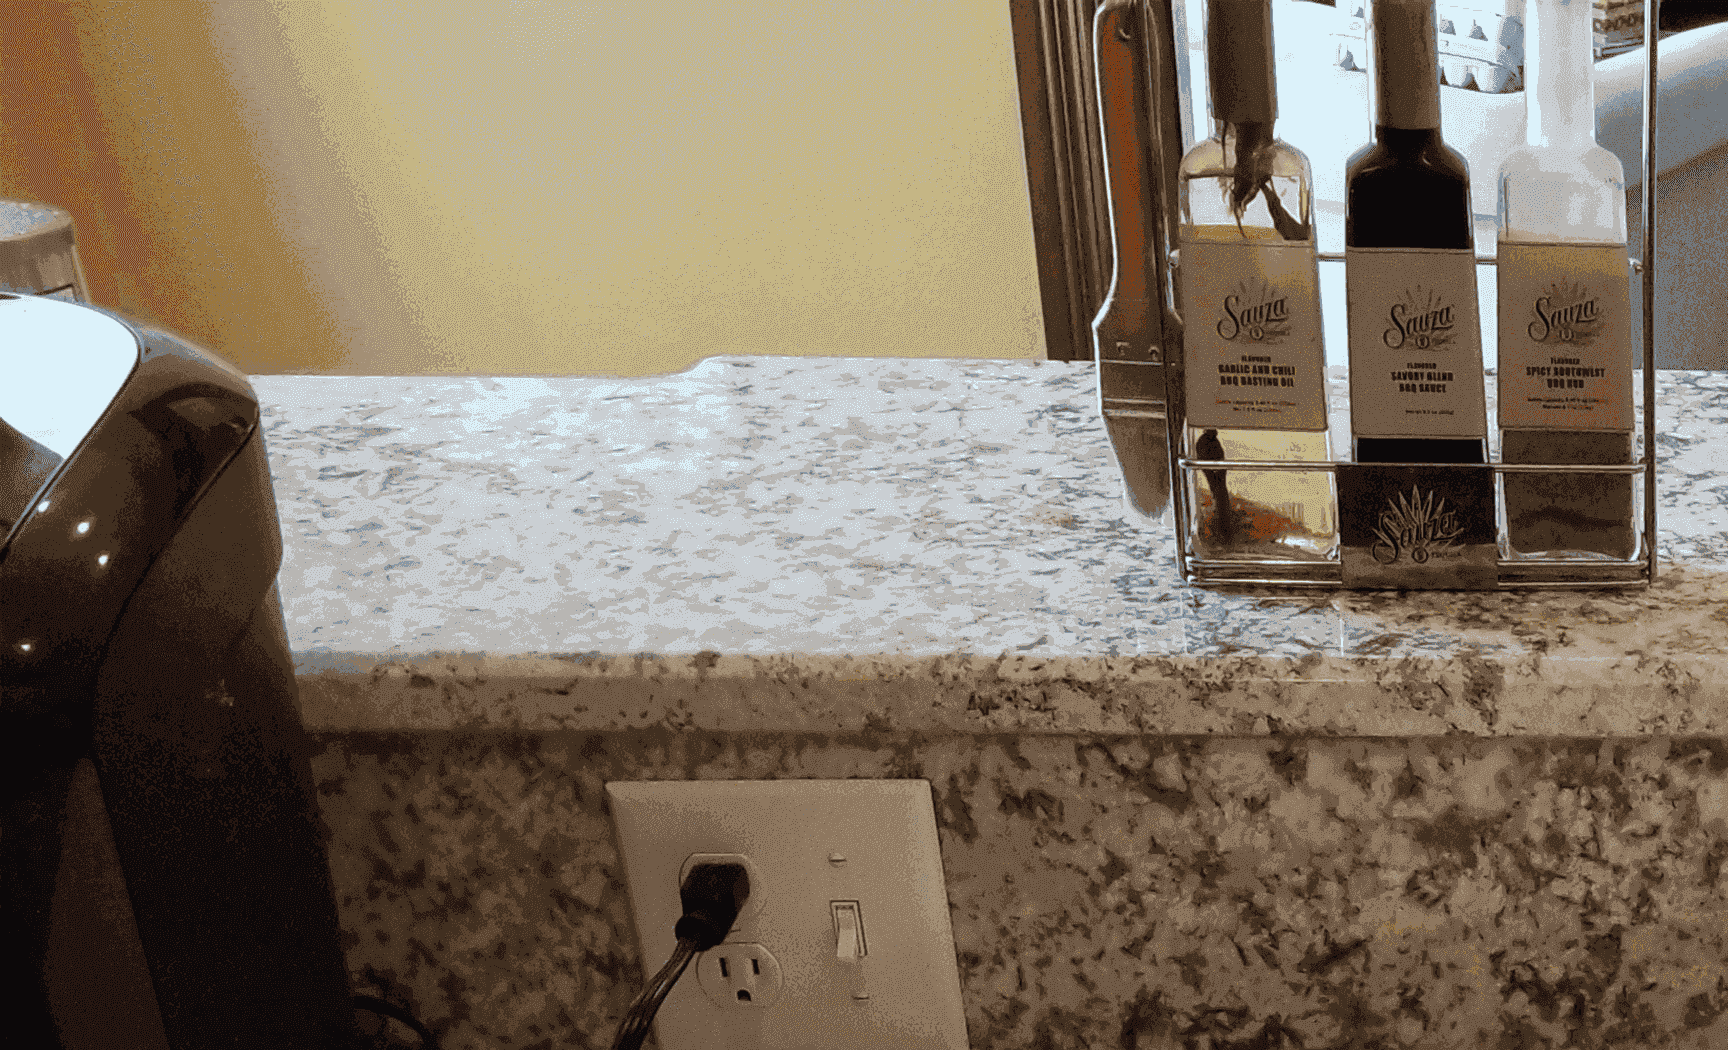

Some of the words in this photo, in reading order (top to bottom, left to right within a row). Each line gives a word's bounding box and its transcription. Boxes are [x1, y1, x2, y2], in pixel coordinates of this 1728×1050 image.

[1217, 295, 1289, 340] Sauza
[1528, 296, 1599, 341] Sauza
[1383, 303, 1455, 349] Sauza
[1251, 364, 1271, 375] AND
[1525, 366, 1552, 376] SPICY
[1390, 371, 1425, 381] SAVORY
[1240, 376, 1279, 387] BASTING
[1280, 377, 1295, 388] OIL
[1418, 384, 1447, 394] SAUCE
